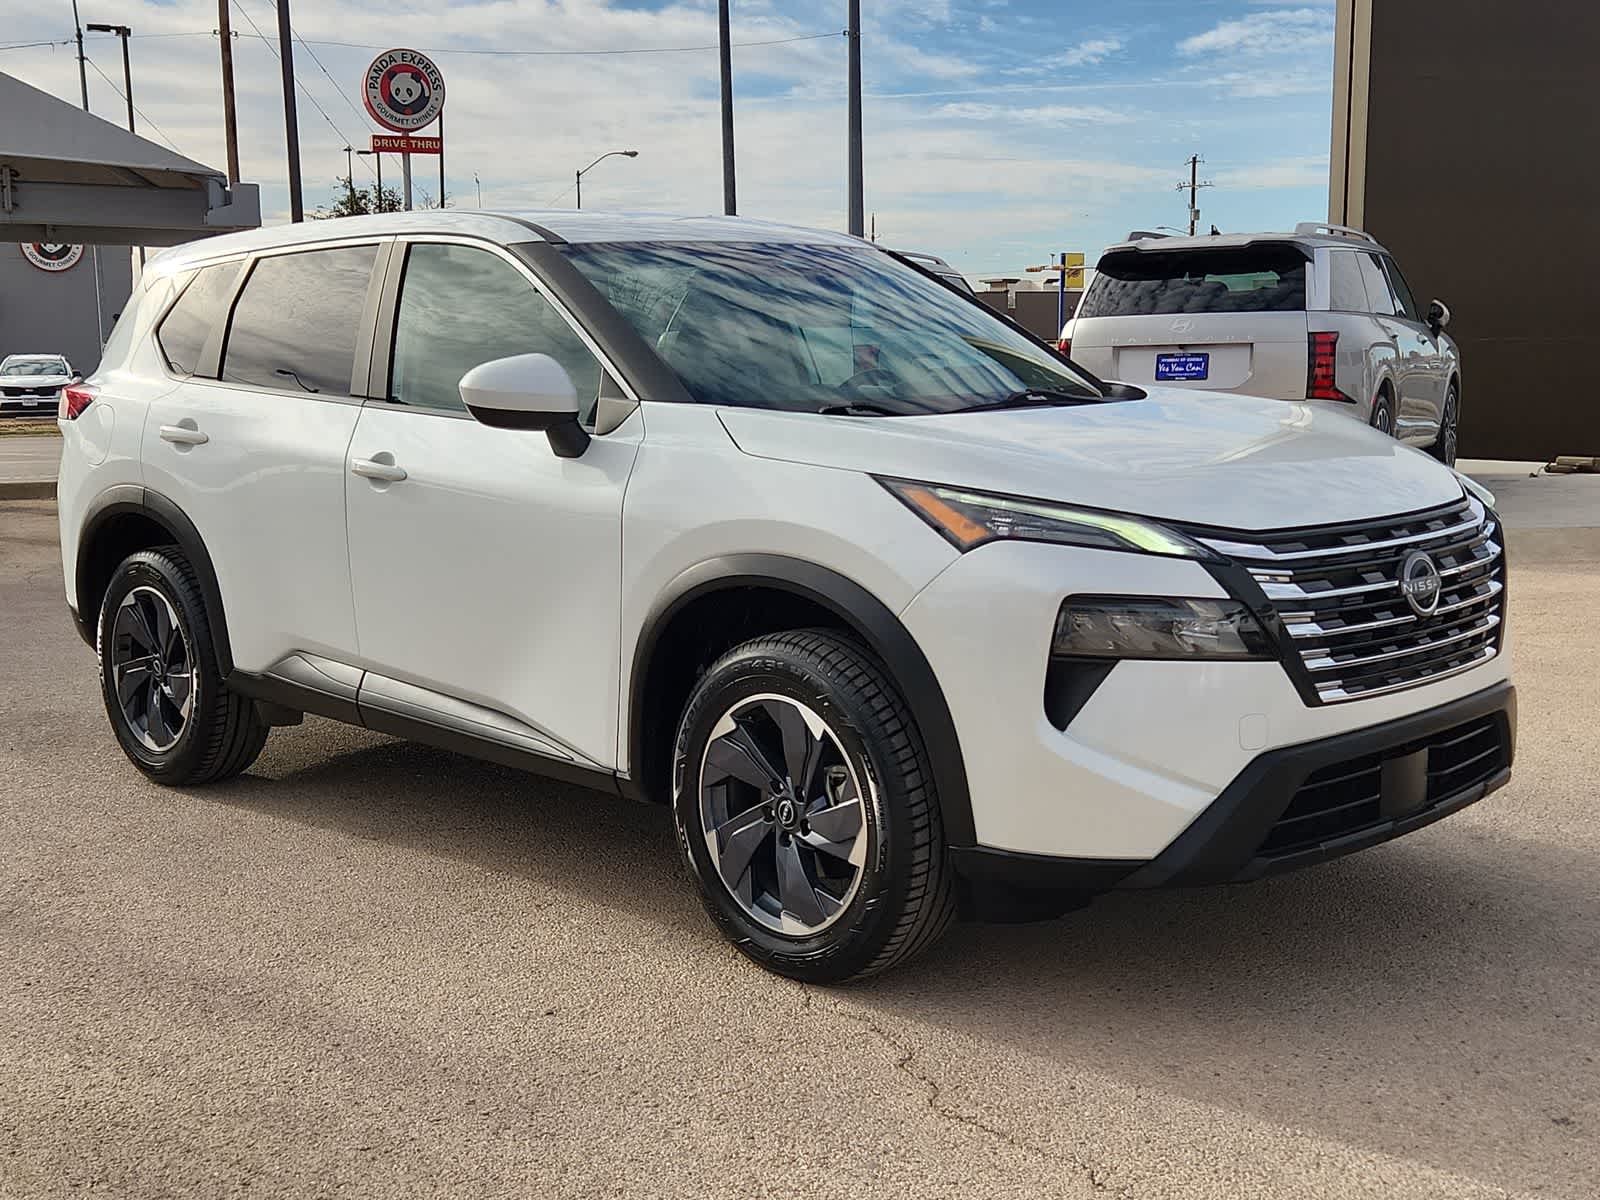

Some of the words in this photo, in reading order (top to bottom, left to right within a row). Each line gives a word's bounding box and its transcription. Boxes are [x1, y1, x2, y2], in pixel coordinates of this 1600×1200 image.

[369, 54, 397, 90] PANDA
[401, 52, 441, 91] EXPRESS
[376, 102, 409, 126] GOURMET
[373, 138, 407, 148] DRIVE
[410, 139, 440, 149] THRU
[1158, 363, 1170, 372] Yes
